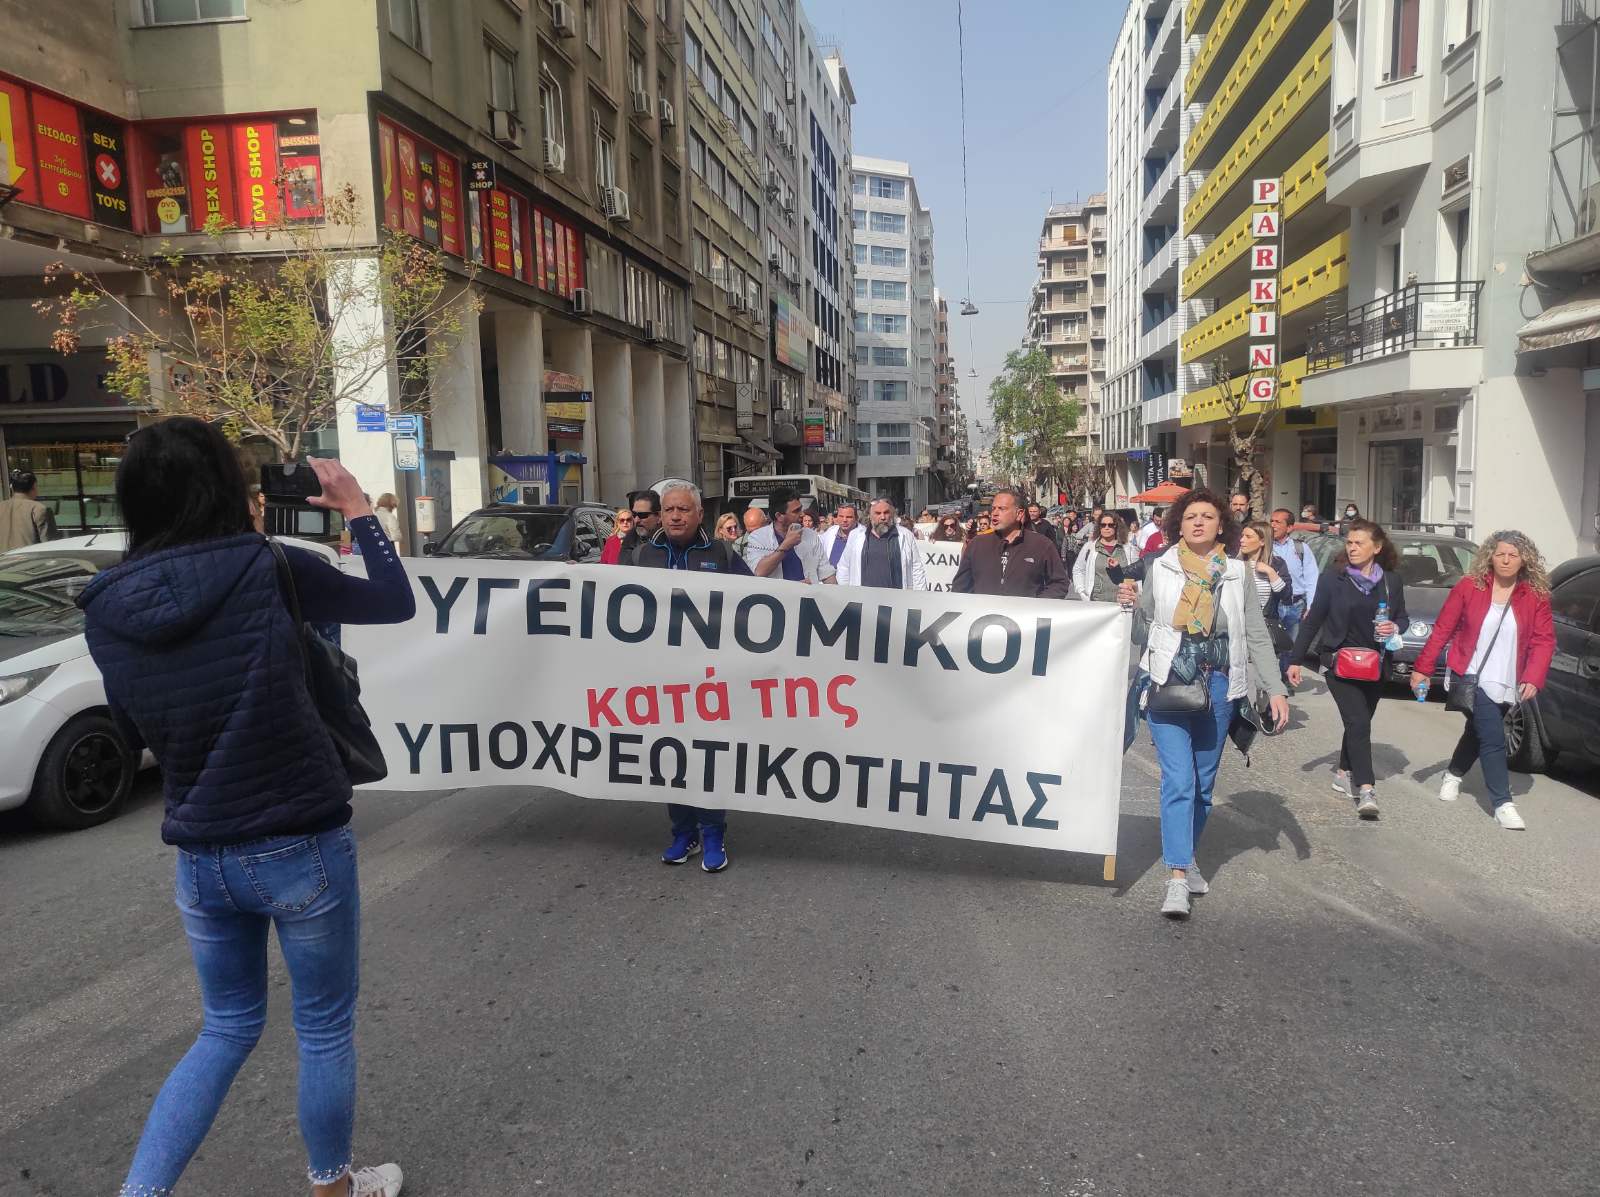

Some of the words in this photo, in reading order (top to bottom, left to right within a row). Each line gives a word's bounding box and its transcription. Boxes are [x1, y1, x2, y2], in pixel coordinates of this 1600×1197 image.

[37, 123, 79, 146] ΕΙΣΟΔΟΣ
[93, 132, 117, 151] SEX
[201, 128, 218, 182] SHOP
[246, 126, 262, 179] SHOP
[471, 161, 488, 170] SEX
[470, 181, 493, 189] SHOP
[95, 193, 127, 212] TOYS
[252, 184, 266, 223] DVD
[493, 197, 505, 207] SEX
[492, 208, 508, 220] SHOP
[494, 240, 509, 251] SHOP
[1252, 181, 1276, 398] PARKING
[417, 575, 1052, 677] ΥΓΕΙΟΝΟΜΙΚΟΙ
[586, 666, 731, 728] κατά
[749, 674, 860, 729] της
[394, 720, 1063, 831] ΥΠΟΧΡΕΩΤΙΚΟΤΗΤΑΣ
